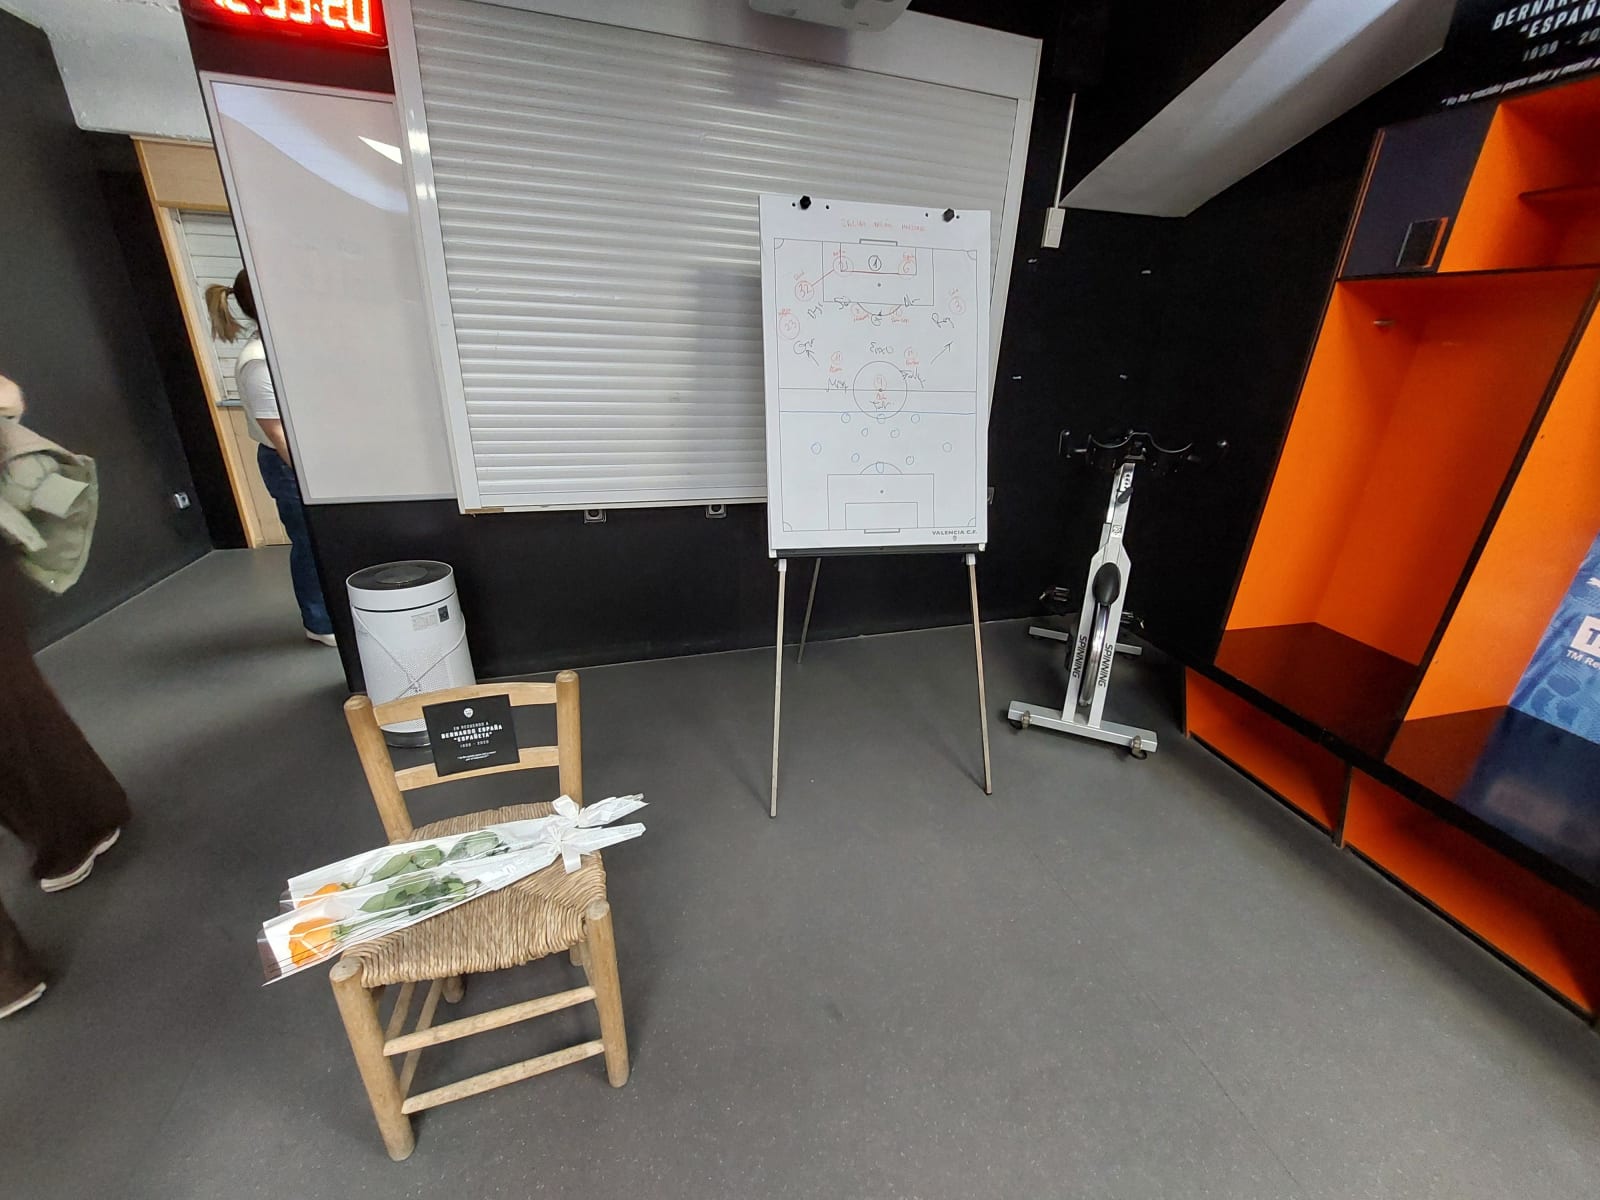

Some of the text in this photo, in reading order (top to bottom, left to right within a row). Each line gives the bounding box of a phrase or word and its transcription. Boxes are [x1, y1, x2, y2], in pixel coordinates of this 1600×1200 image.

[1072, 634, 1088, 679] SPINNING
[1098, 643, 1114, 688] SPINNING
[1566, 650, 1600, 671] TM Re
[441, 724, 502, 739] BERNARDO ESPAÑA
